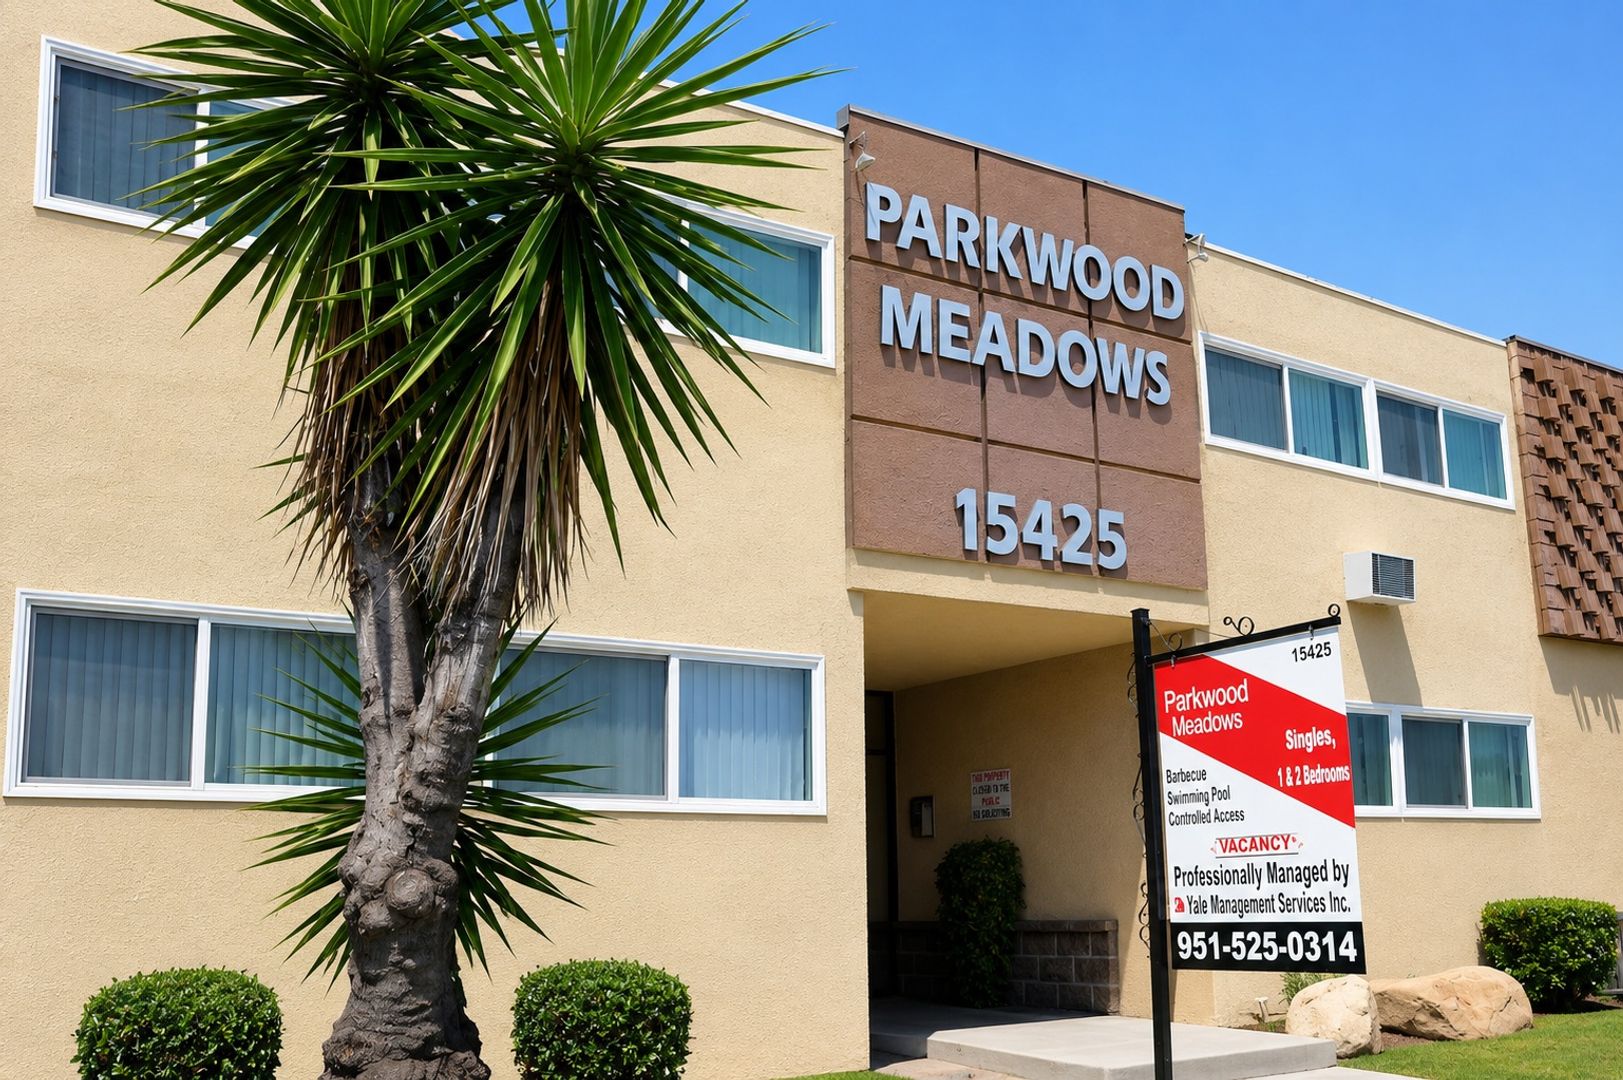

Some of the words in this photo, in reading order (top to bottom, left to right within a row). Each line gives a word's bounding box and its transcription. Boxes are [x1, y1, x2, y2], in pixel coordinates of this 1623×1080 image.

[865, 181, 1185, 321] PARKWOOD
[880, 284, 1172, 406] MEADOWS
[955, 487, 1128, 571] 15425
[1292, 641, 1332, 663] 15425
[1163, 678, 1249, 714] Parkwood
[1171, 711, 1243, 737] Meadows
[1285, 726, 1336, 753] Singles,
[1166, 768, 1207, 784] Barbecue
[1277, 769, 1283, 787] 1
[1286, 767, 1293, 786] &
[1295, 766, 1301, 786] 2
[1303, 763, 1350, 785] Bedrooms
[1167, 788, 1209, 806] Swimming
[1211, 785, 1231, 801] Pool
[1168, 807, 1211, 826] Controlled
[1213, 808, 1245, 823] Access
[1218, 834, 1290, 853] VACANCY
[1173, 861, 1263, 890] Professionally
[1267, 859, 1328, 888] Managed
[1332, 858, 1350, 887] by
[1186, 895, 1208, 915] Yale
[1210, 894, 1276, 919] Management
[1278, 891, 1327, 914] Services
[1329, 891, 1351, 913] Inc.
[1177, 931, 1358, 962] 951-525-0314
